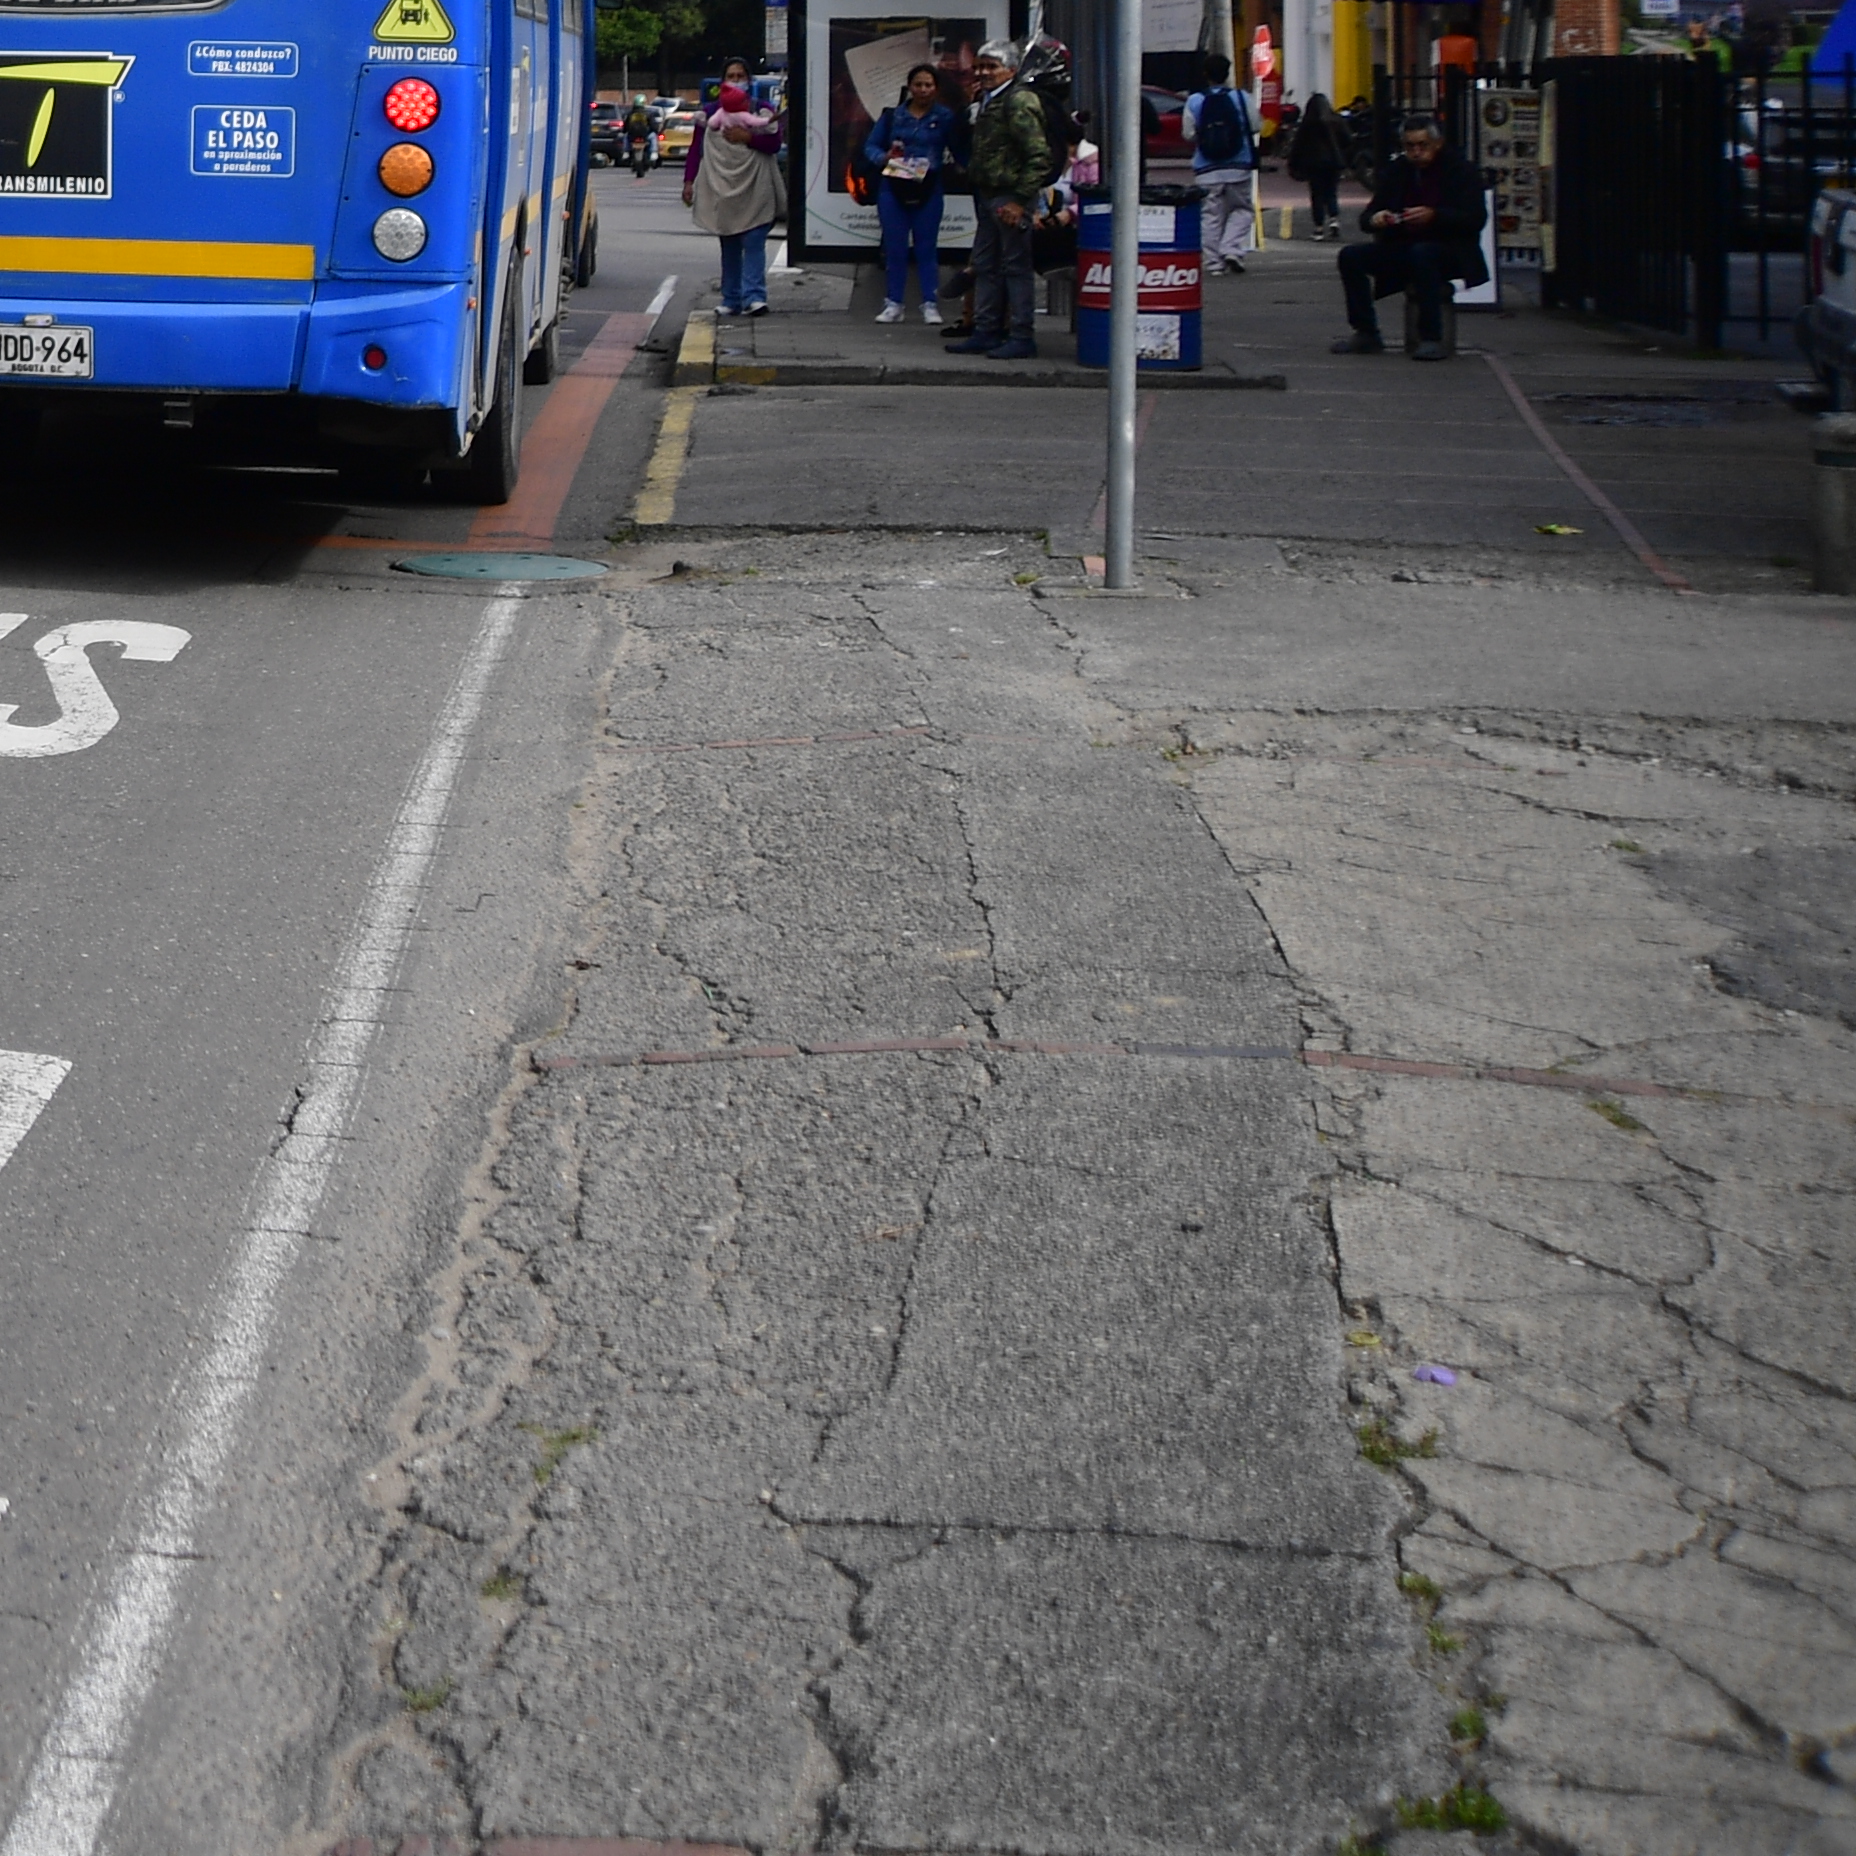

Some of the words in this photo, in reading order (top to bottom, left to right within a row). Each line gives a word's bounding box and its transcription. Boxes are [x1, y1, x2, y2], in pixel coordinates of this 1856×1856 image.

[195, 46, 233, 58] ¿Cómo
[235, 47, 292, 59] conduzco?
[369, 46, 413, 60] PUNTO
[417, 47, 458, 62] CIEGO
[220, 110, 267, 129] CEDA
[208, 130, 228, 148] EL
[233, 131, 279, 149] PASO
[203, 150, 216, 159] en
[222, 161, 272, 174] paraderos
[12, 364, 45, 373] BOGOTA
